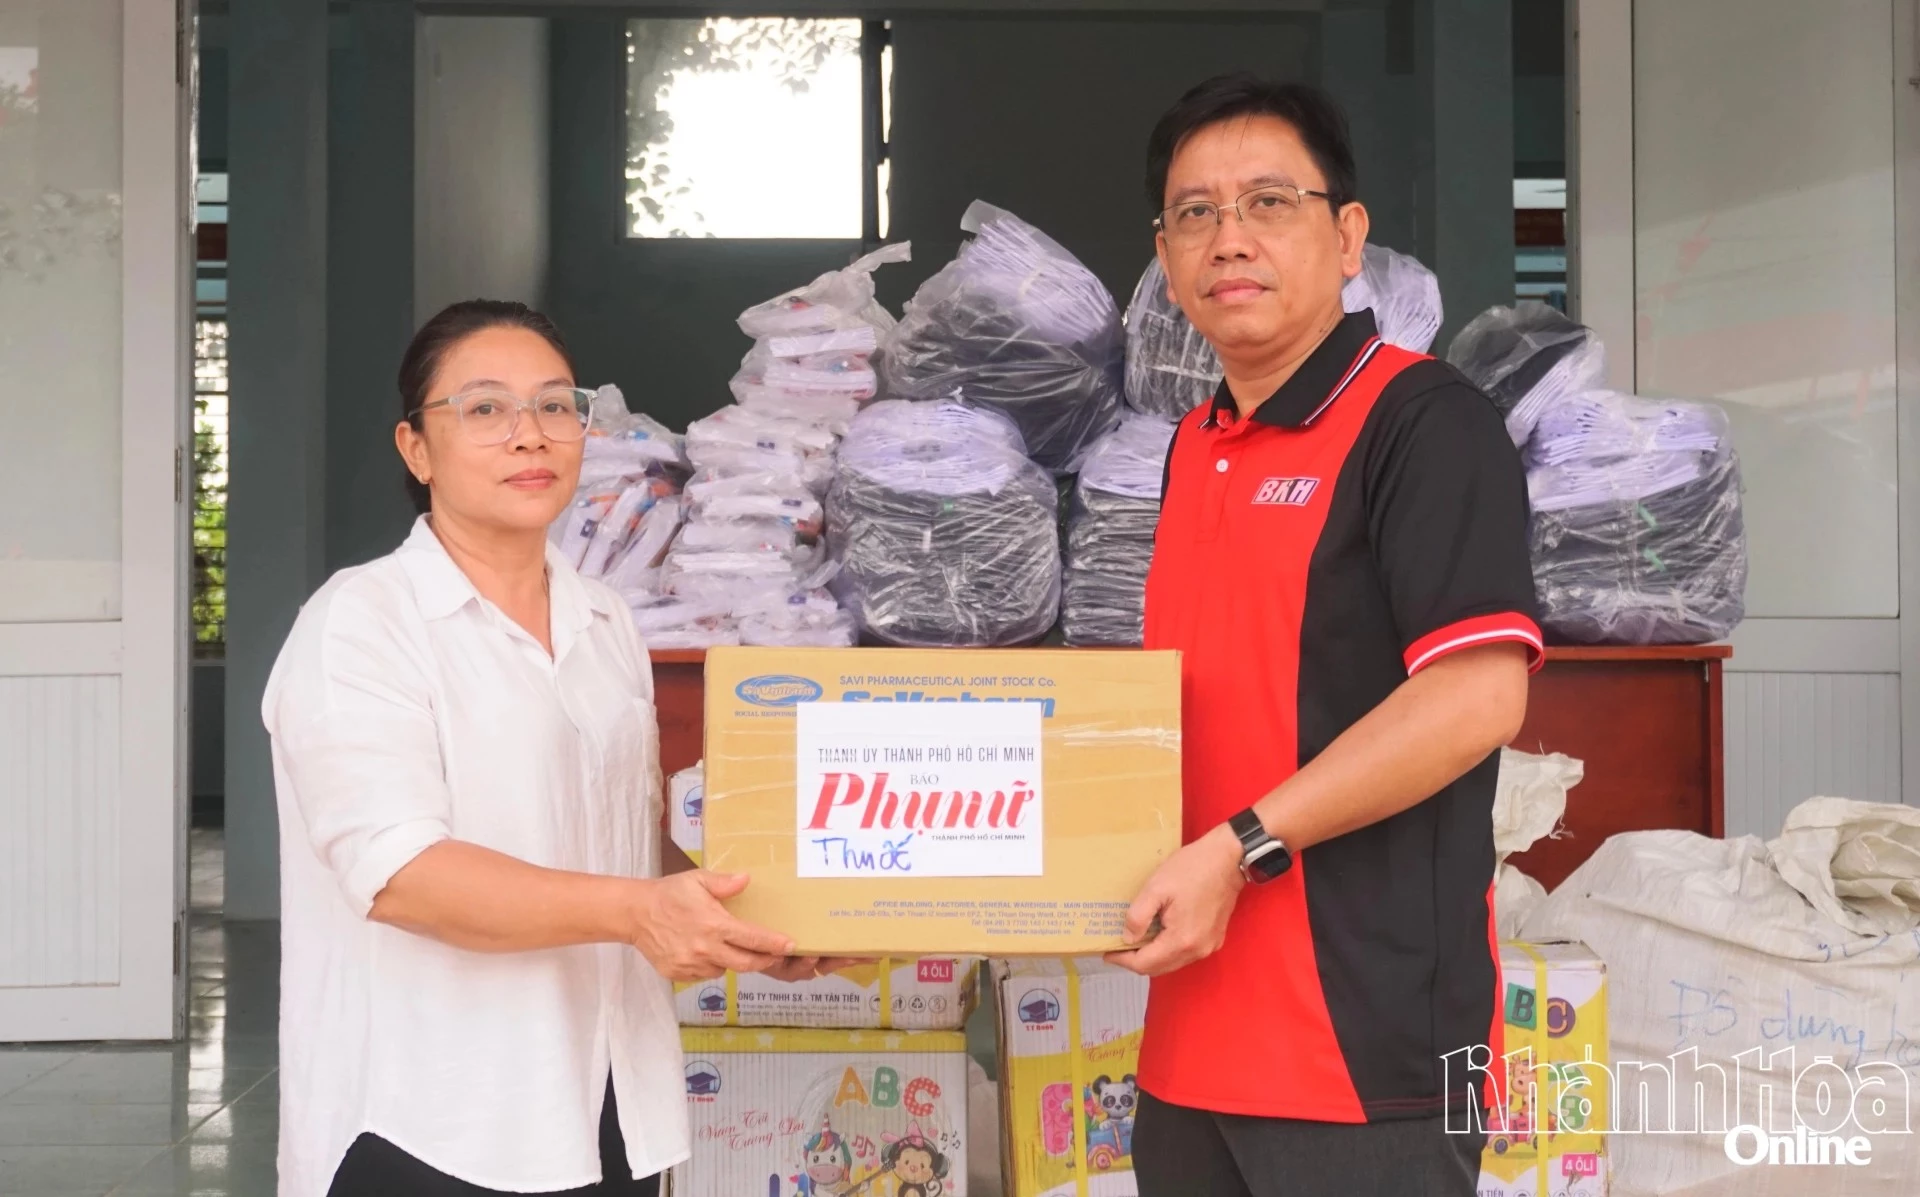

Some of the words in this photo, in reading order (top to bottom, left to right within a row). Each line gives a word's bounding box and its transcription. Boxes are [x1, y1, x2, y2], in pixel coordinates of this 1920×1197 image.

[840, 676, 864, 686] SAVI
[867, 676, 966, 686] PHARMACEUTICAL
[968, 677, 998, 686] JOINT
[1001, 677, 1035, 687] STOCK
[1038, 677, 1057, 687] Co.
[1003, 747, 1034, 762] MINH
[920, 965, 928, 978] 4
[738, 990, 754, 1001] ÔNG
[757, 992, 766, 1001] TY
[768, 992, 789, 1002] TNHH
[792, 993, 802, 1002] SX
[810, 994, 822, 1003] TM
